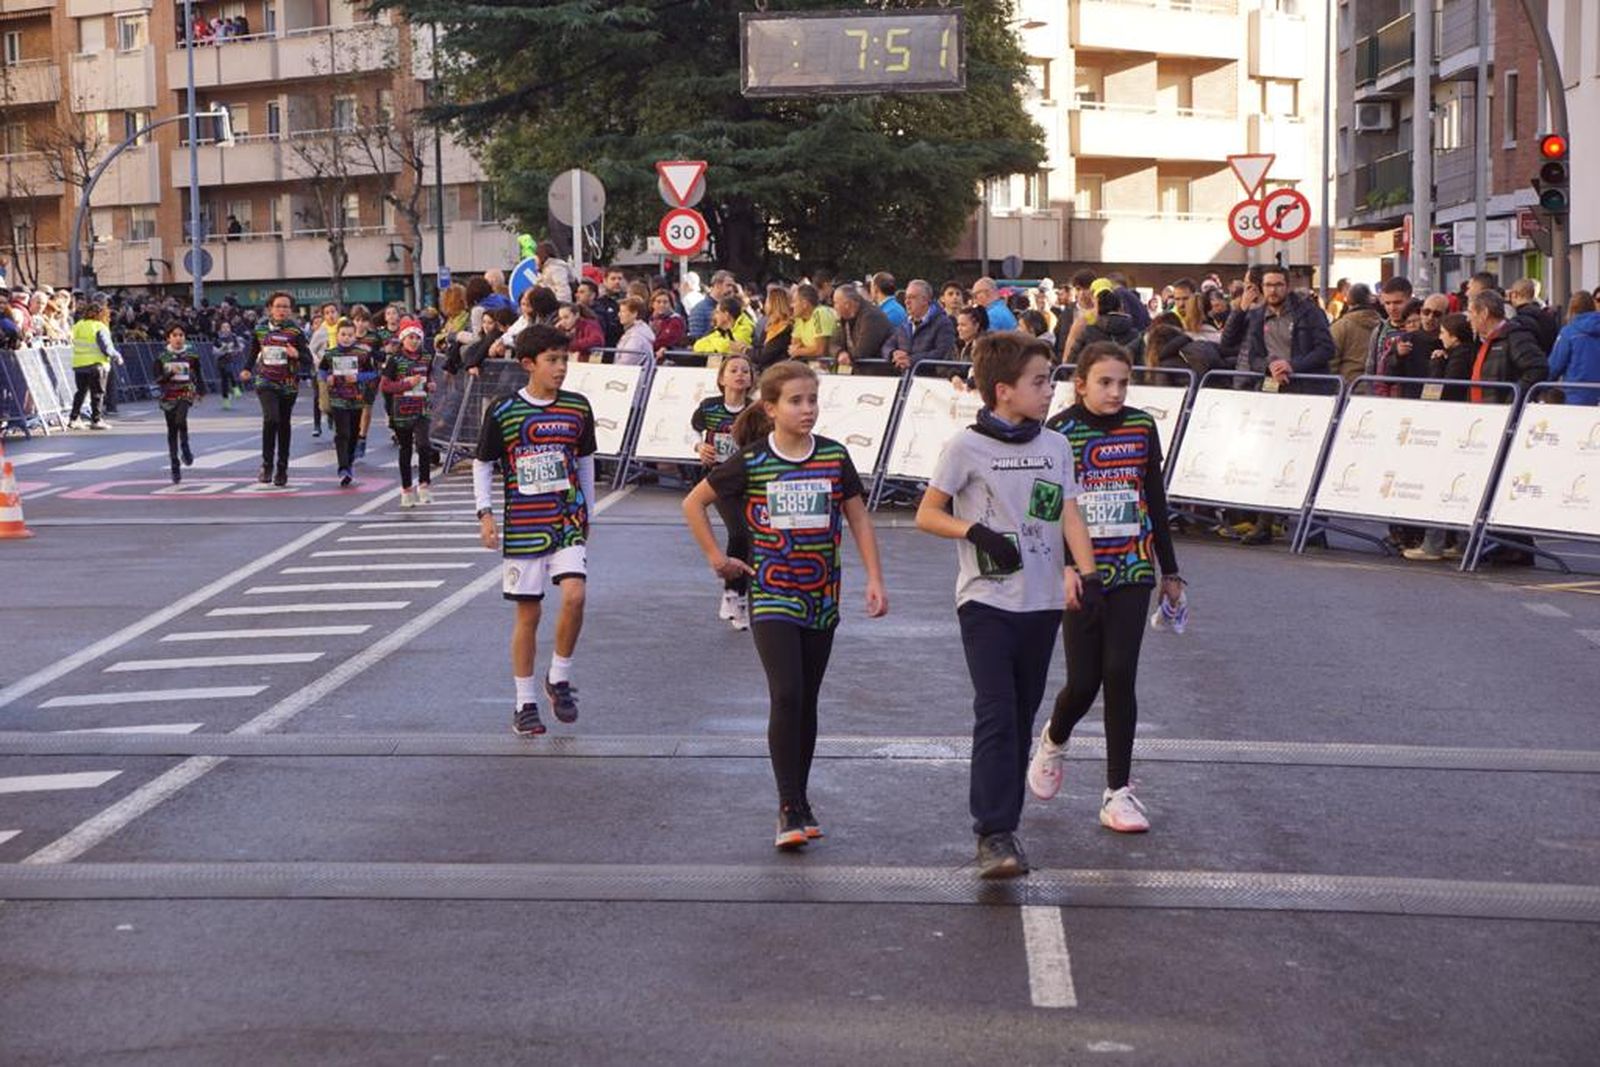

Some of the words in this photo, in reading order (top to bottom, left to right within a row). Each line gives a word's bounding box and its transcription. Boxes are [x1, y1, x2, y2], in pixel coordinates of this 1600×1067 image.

[671, 225, 695, 240] 30
[524, 464, 558, 482] 5763
[776, 493, 818, 513] 5897
[1086, 504, 1126, 523] 5827
